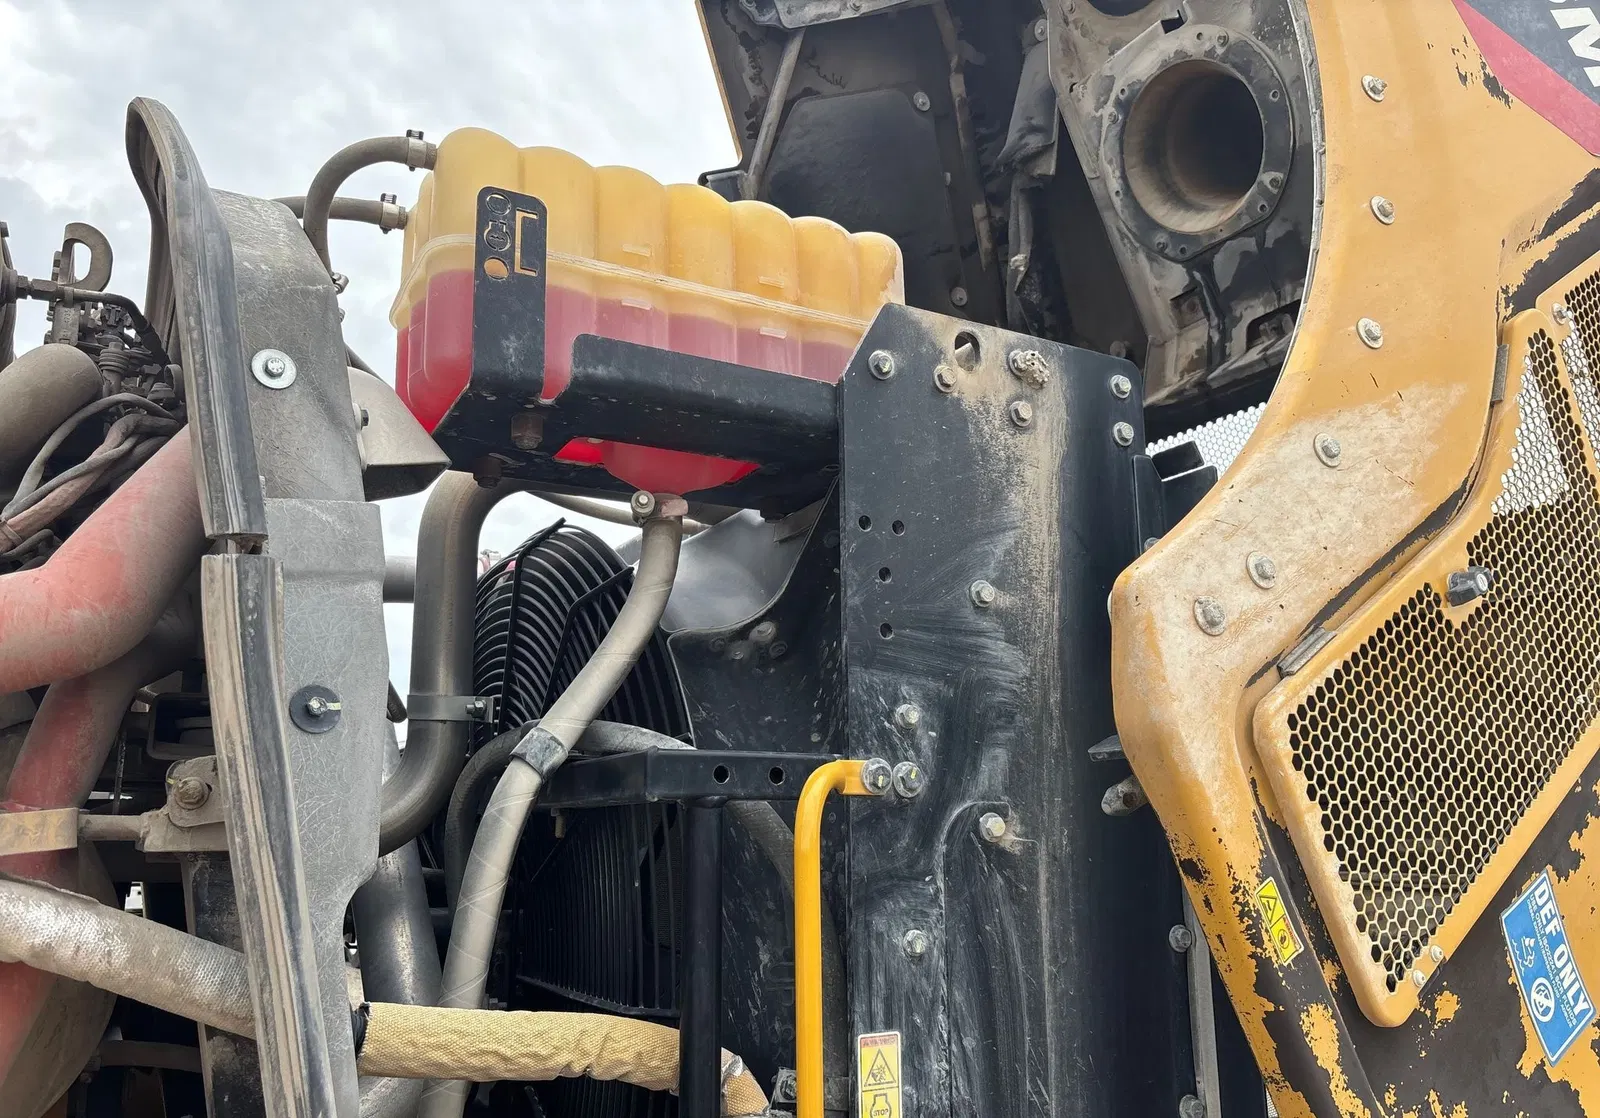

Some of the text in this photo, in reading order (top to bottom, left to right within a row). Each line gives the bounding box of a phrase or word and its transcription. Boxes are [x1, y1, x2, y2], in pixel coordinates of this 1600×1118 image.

[1533, 880, 1590, 1016] DEF ONLY
[1534, 911, 1544, 935] ONLY
[1561, 993, 1577, 1026] FLUIDS
[873, 1108, 889, 1117] STOP
